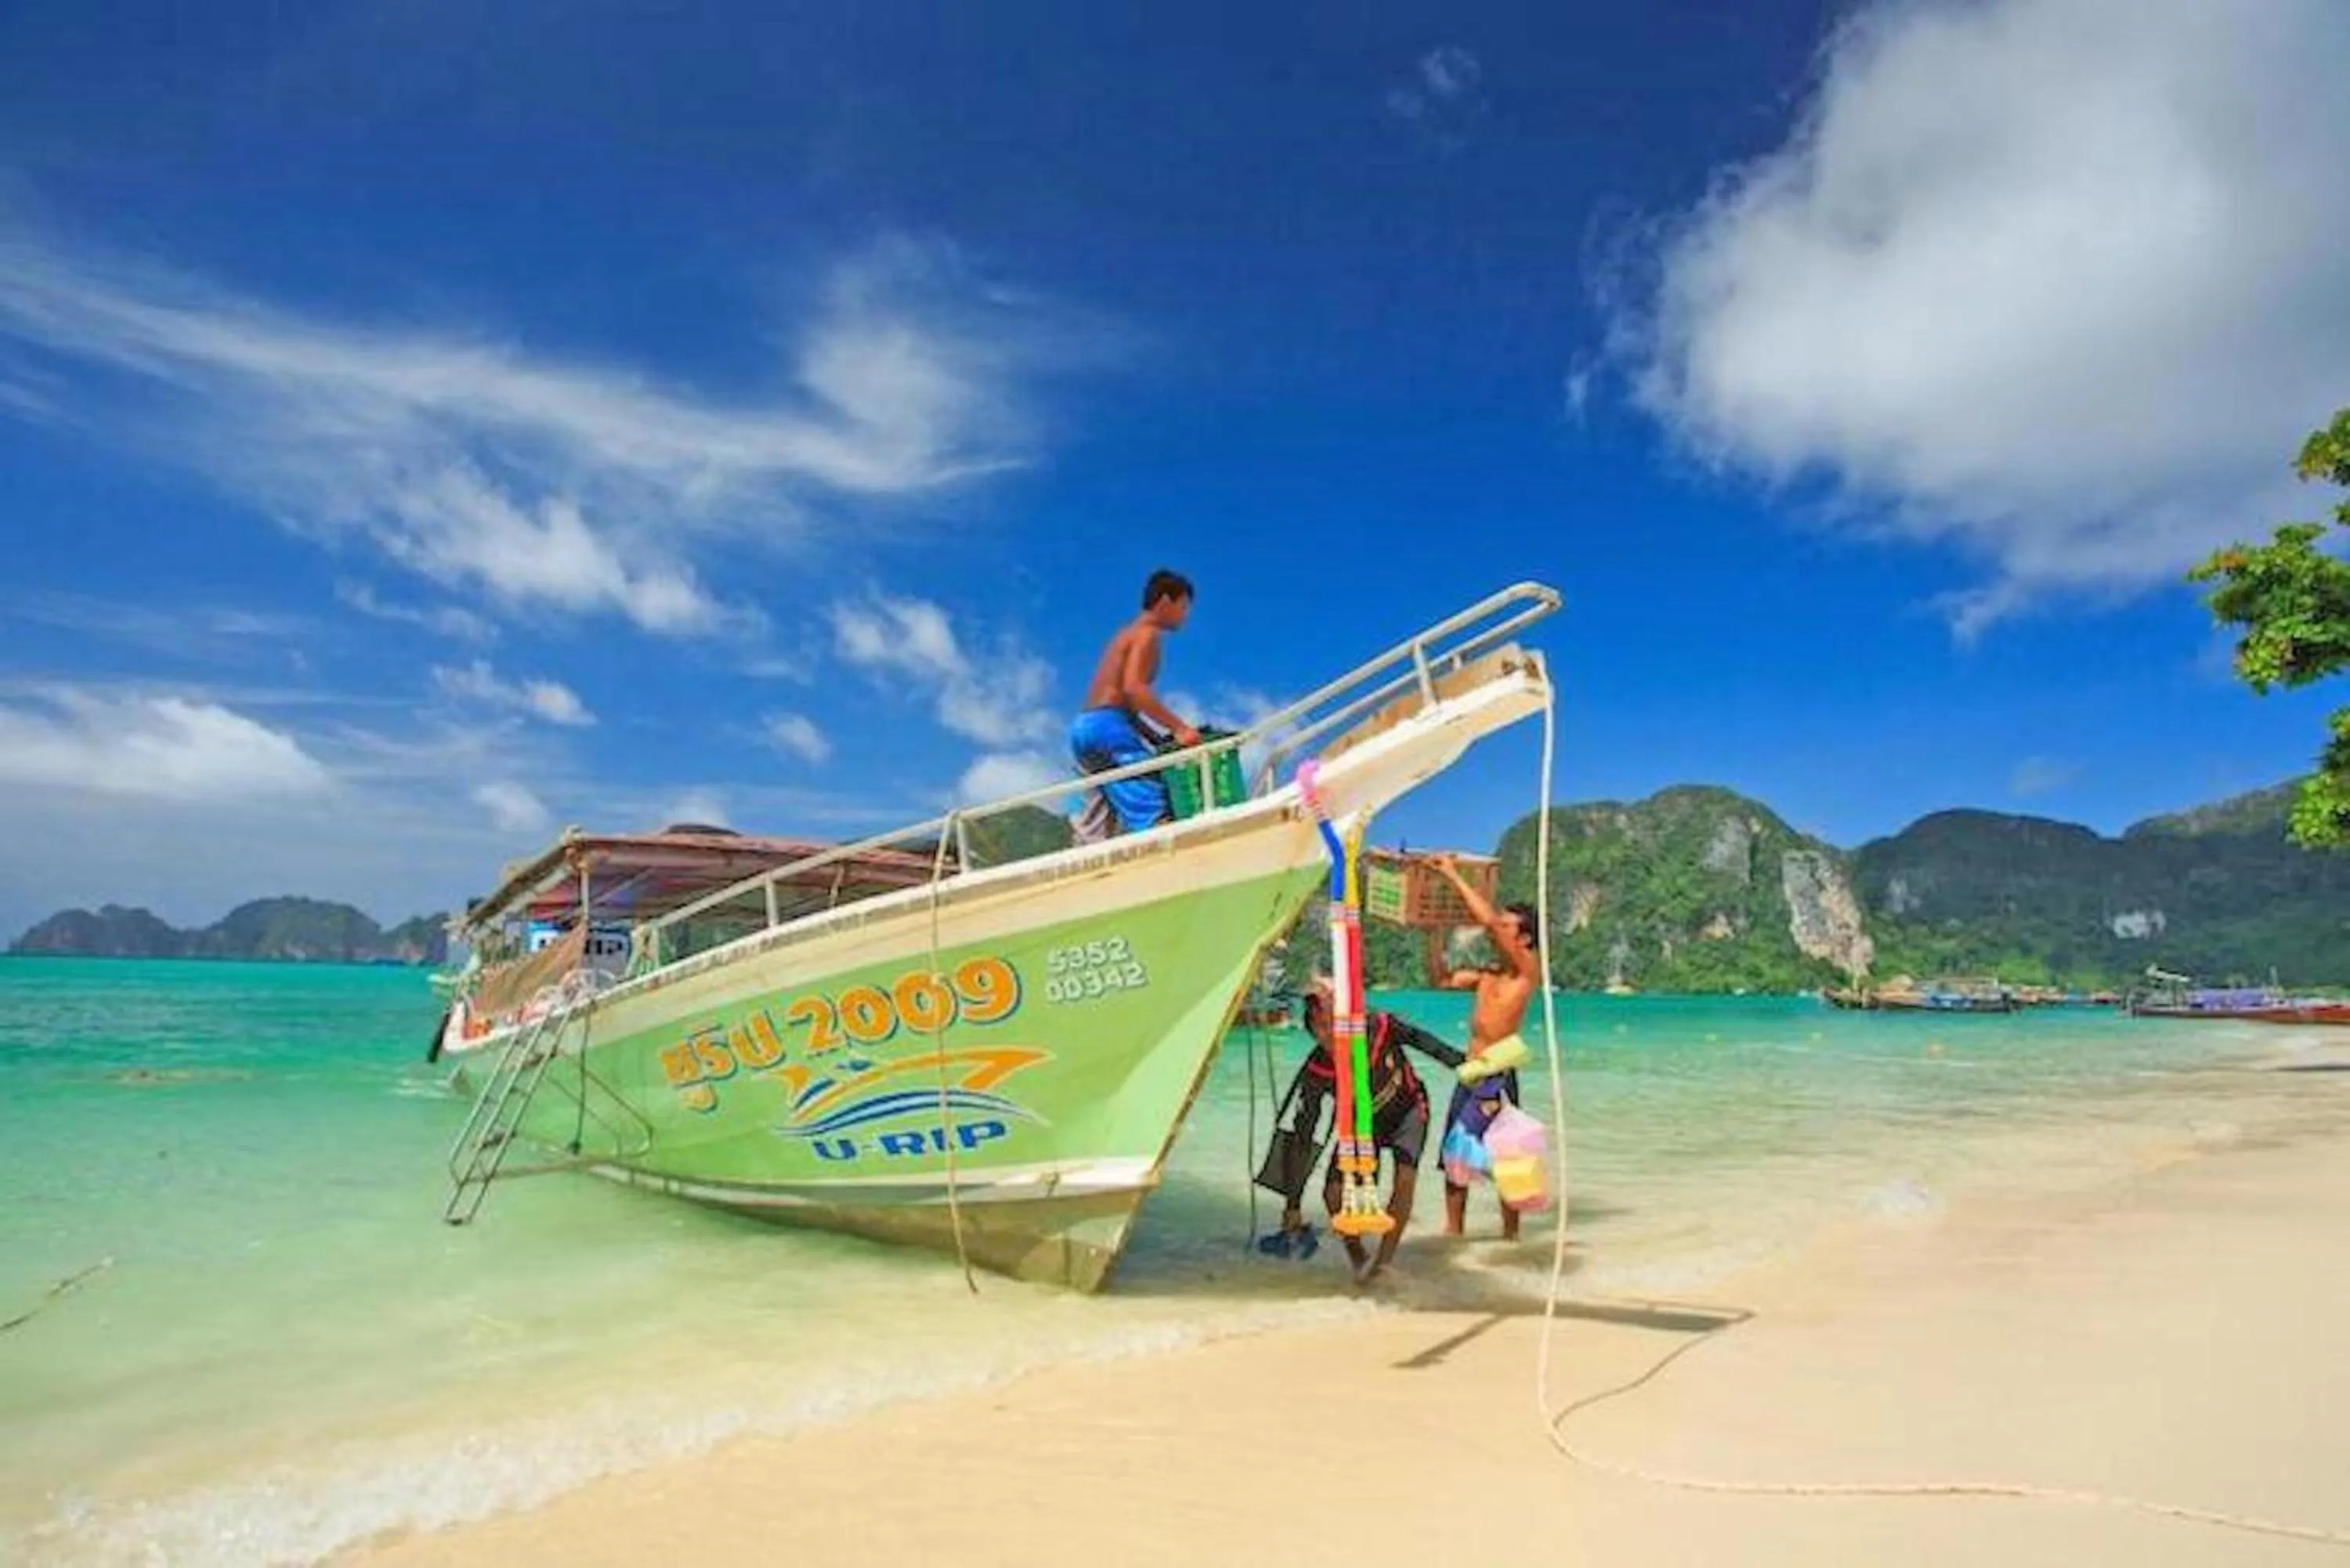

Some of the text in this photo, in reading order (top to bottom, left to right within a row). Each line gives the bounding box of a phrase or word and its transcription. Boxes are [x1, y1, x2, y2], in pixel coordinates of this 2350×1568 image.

[1045, 962, 1148, 1003] 00342
[784, 956, 1021, 1056] 2009
[812, 1121, 1006, 1161] U-RIP
